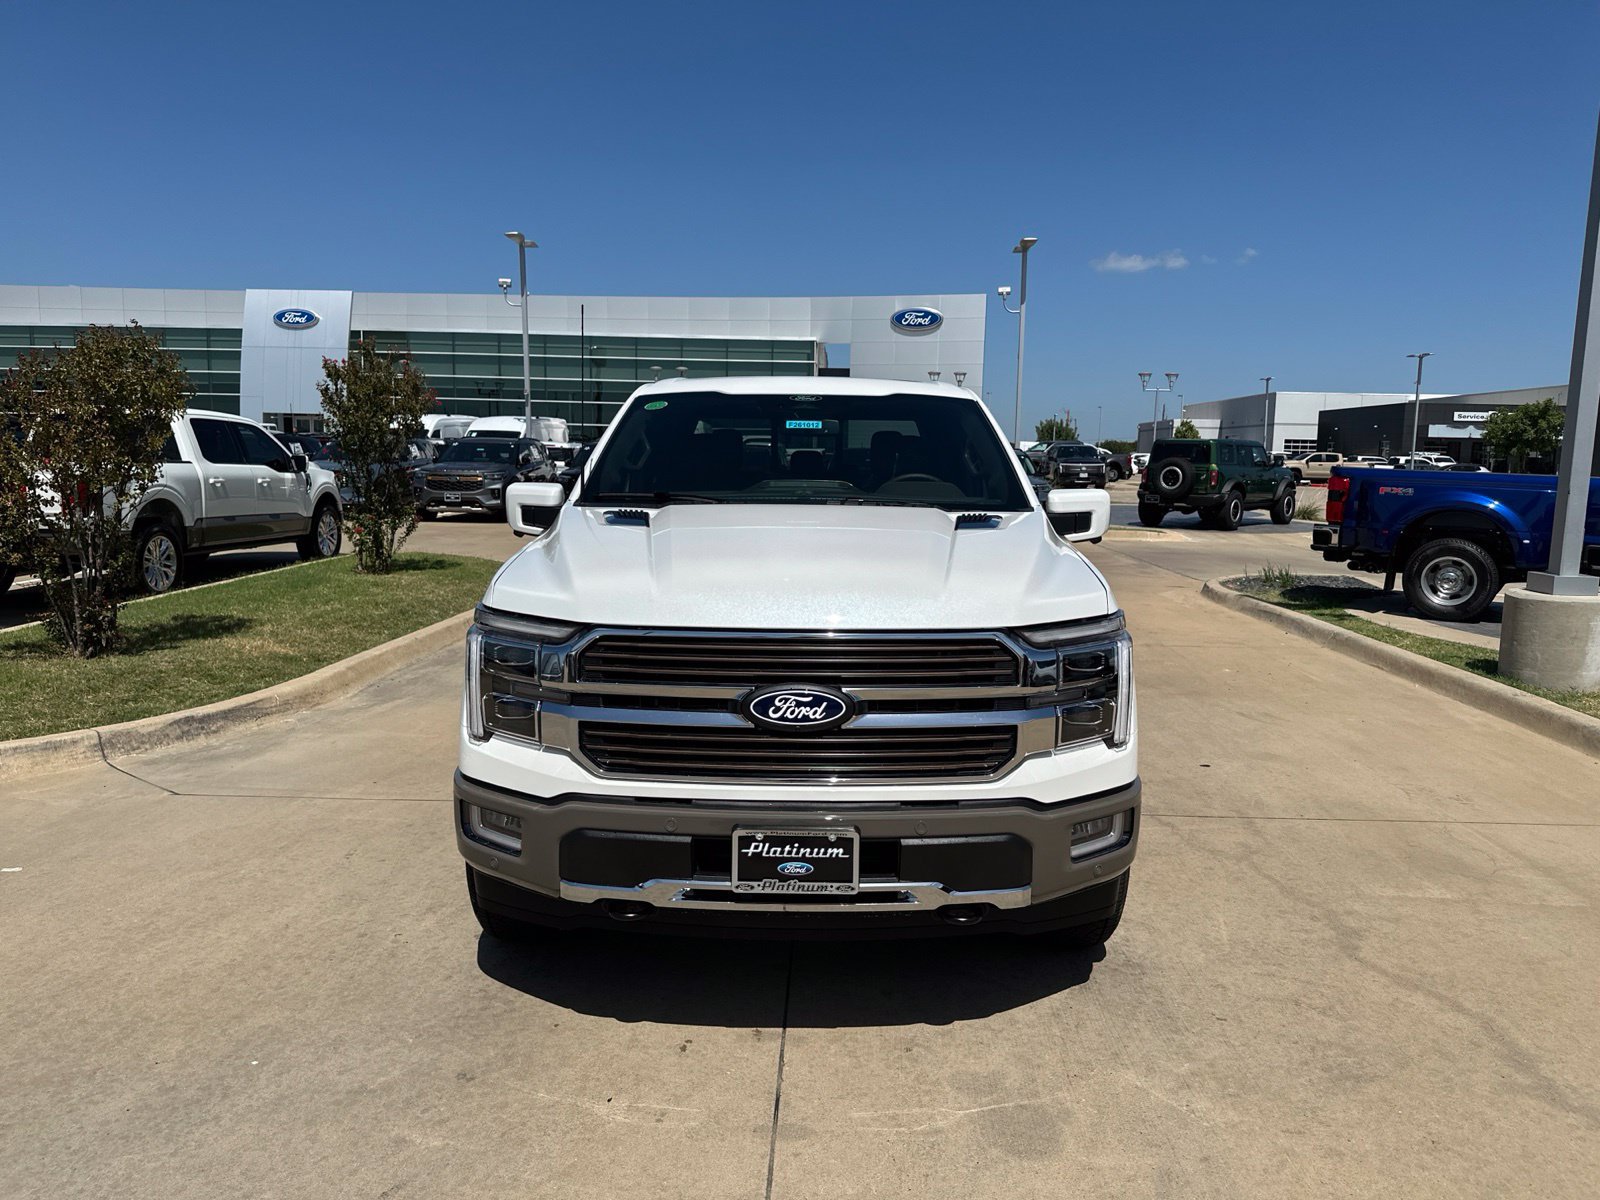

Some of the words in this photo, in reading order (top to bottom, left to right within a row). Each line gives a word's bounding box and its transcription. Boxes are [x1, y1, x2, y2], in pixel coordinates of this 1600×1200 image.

[282, 311, 308, 323] Ford
[901, 311, 932, 325] Ford
[768, 694, 828, 719] Ford
[741, 842, 850, 858] Platinum
[784, 864, 807, 873] Ford
[760, 879, 829, 892] Platinum
